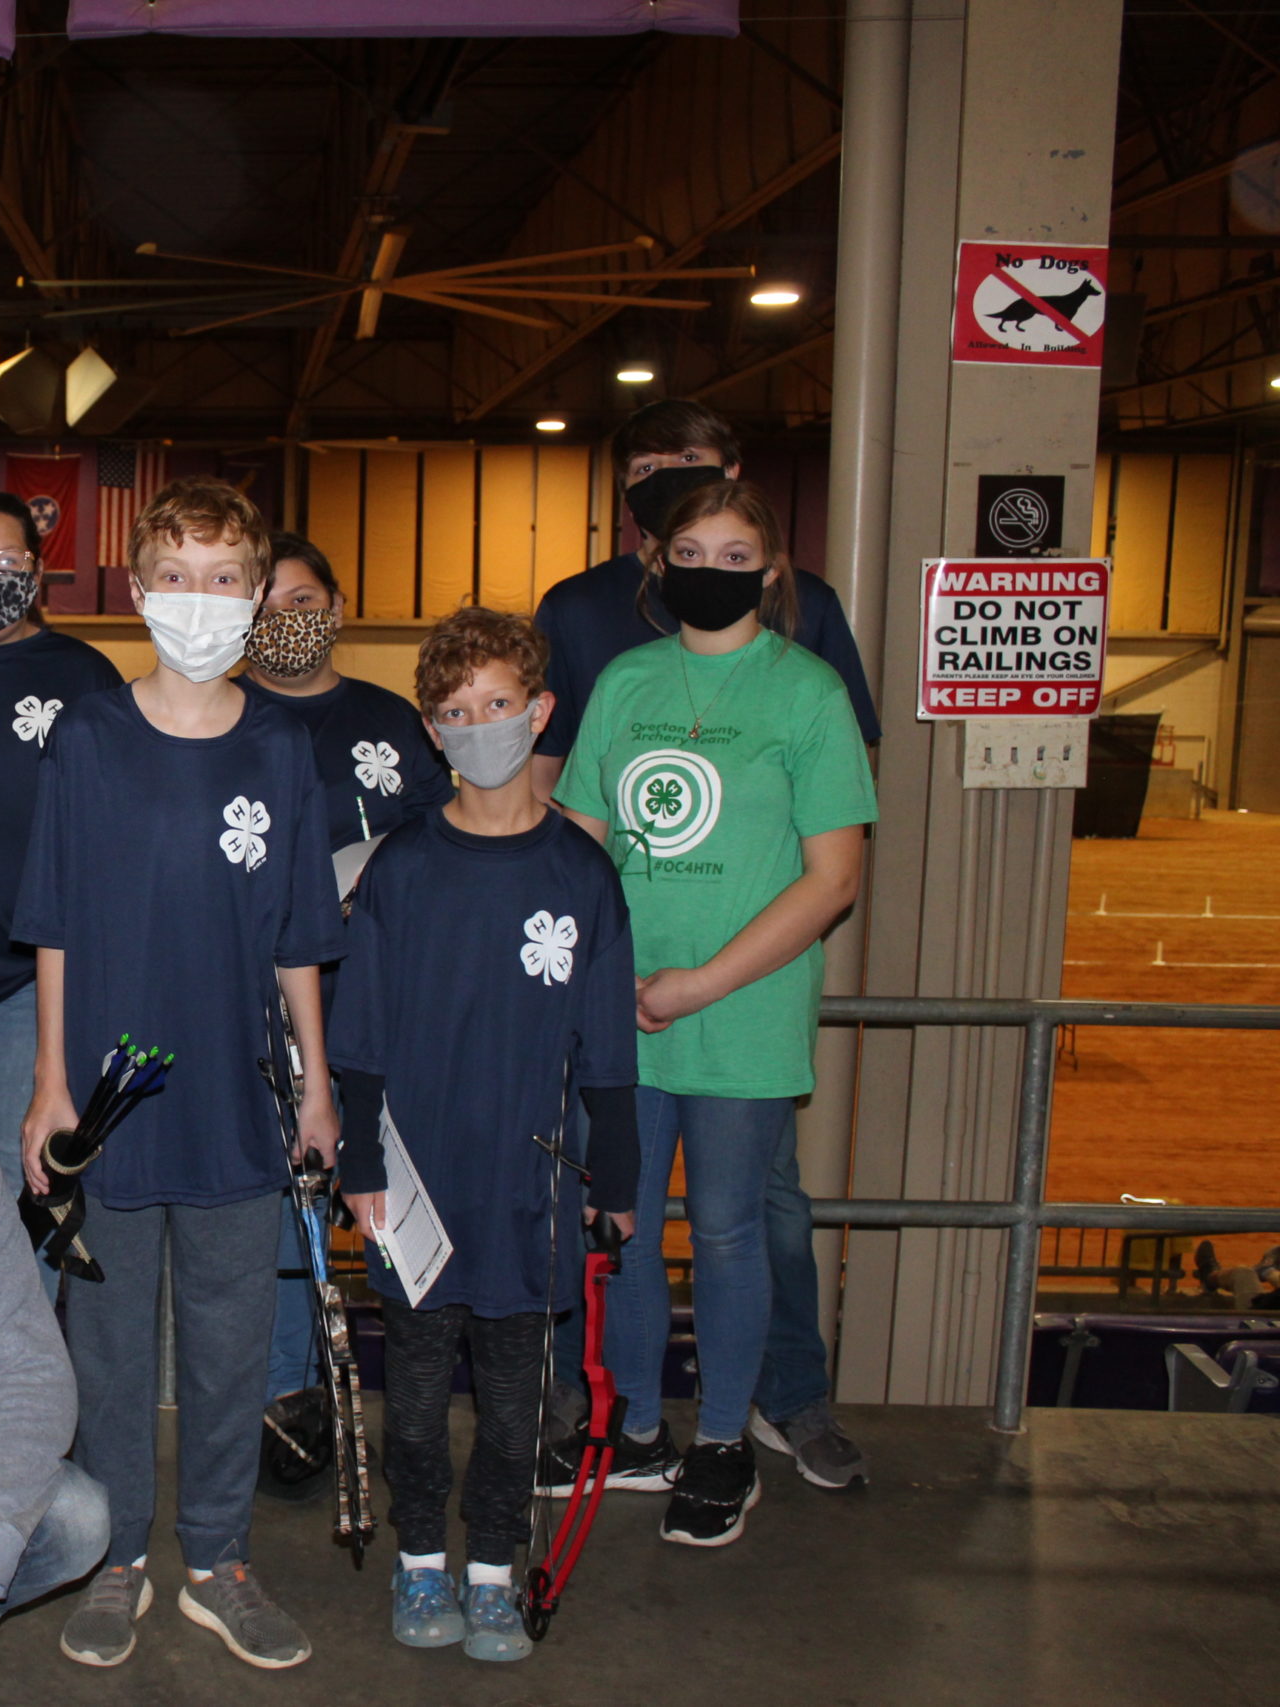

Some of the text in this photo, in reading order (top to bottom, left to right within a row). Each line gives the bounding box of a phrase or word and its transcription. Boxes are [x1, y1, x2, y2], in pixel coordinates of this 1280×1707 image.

[995, 253, 1089, 274] No Dogs
[968, 341, 1088, 354] Allowed In Building
[936, 572, 1101, 591] WARNING
[954, 601, 1082, 620] DO NOT
[934, 626, 1097, 646] CLIMB ON
[938, 651, 1092, 671] RAILINGS
[930, 687, 1096, 707] KEEP OFF
[631, 721, 742, 739] Overton ounty
[631, 731, 688, 746] Archery
[654, 860, 723, 875] #OC4HTN
